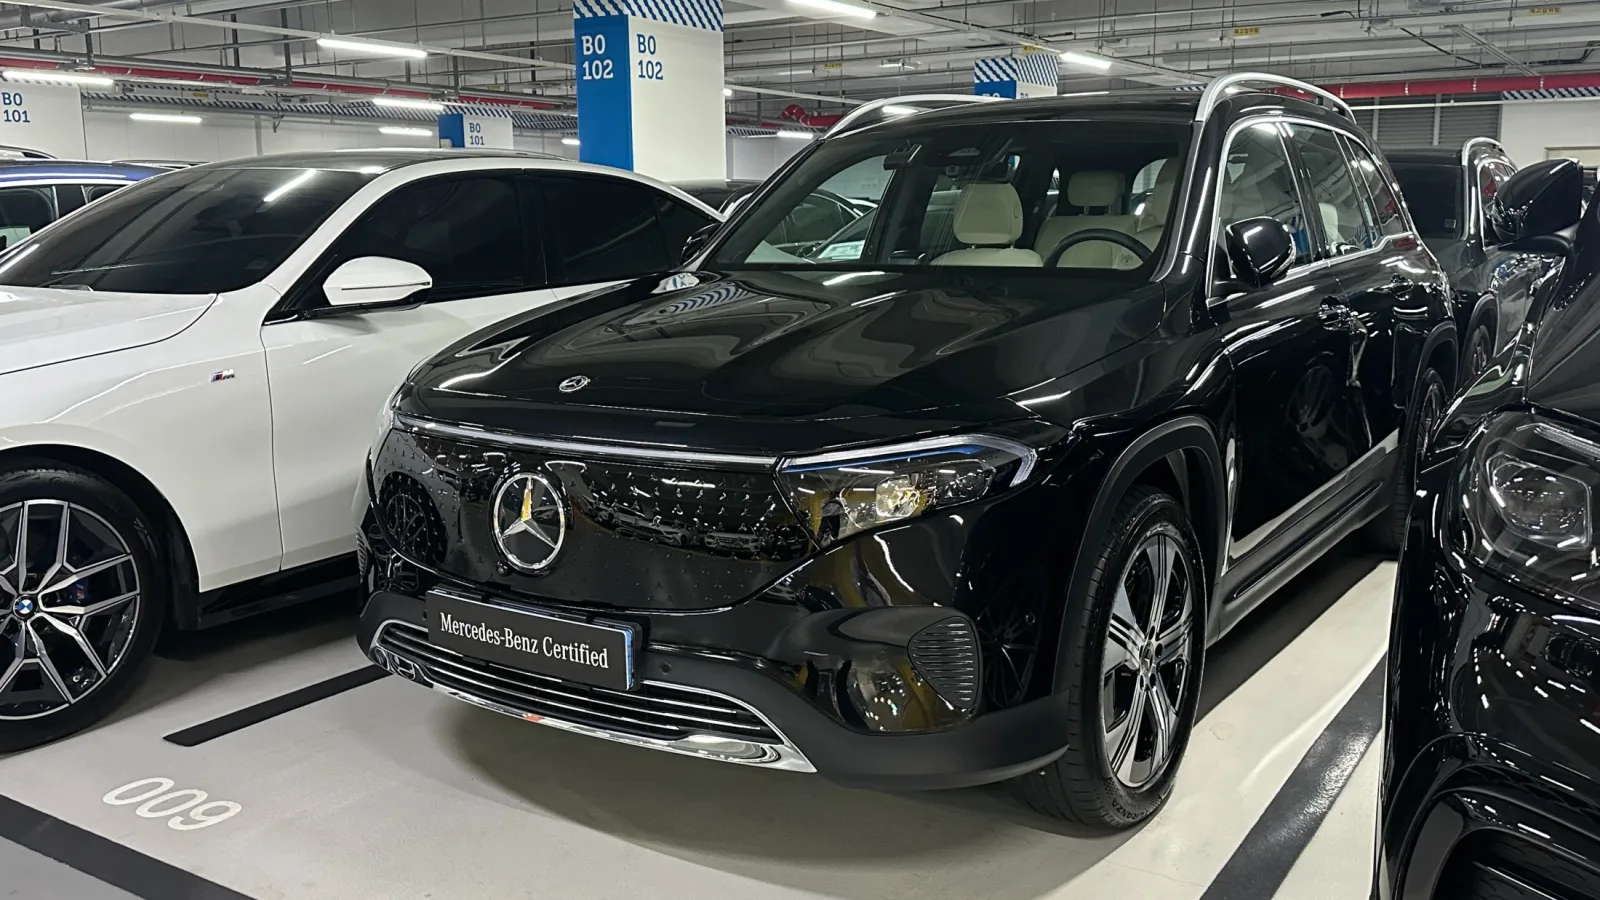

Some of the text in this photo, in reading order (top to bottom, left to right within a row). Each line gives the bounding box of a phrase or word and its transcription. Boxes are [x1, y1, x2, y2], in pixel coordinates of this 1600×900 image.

[582, 59, 614, 80] 102
[638, 60, 663, 80] 102
[3, 109, 31, 123] 101
[470, 135, 485, 146] 101
[440, 612, 609, 669] Mercedes-Benz Certified
[102, 777, 242, 831] 009
